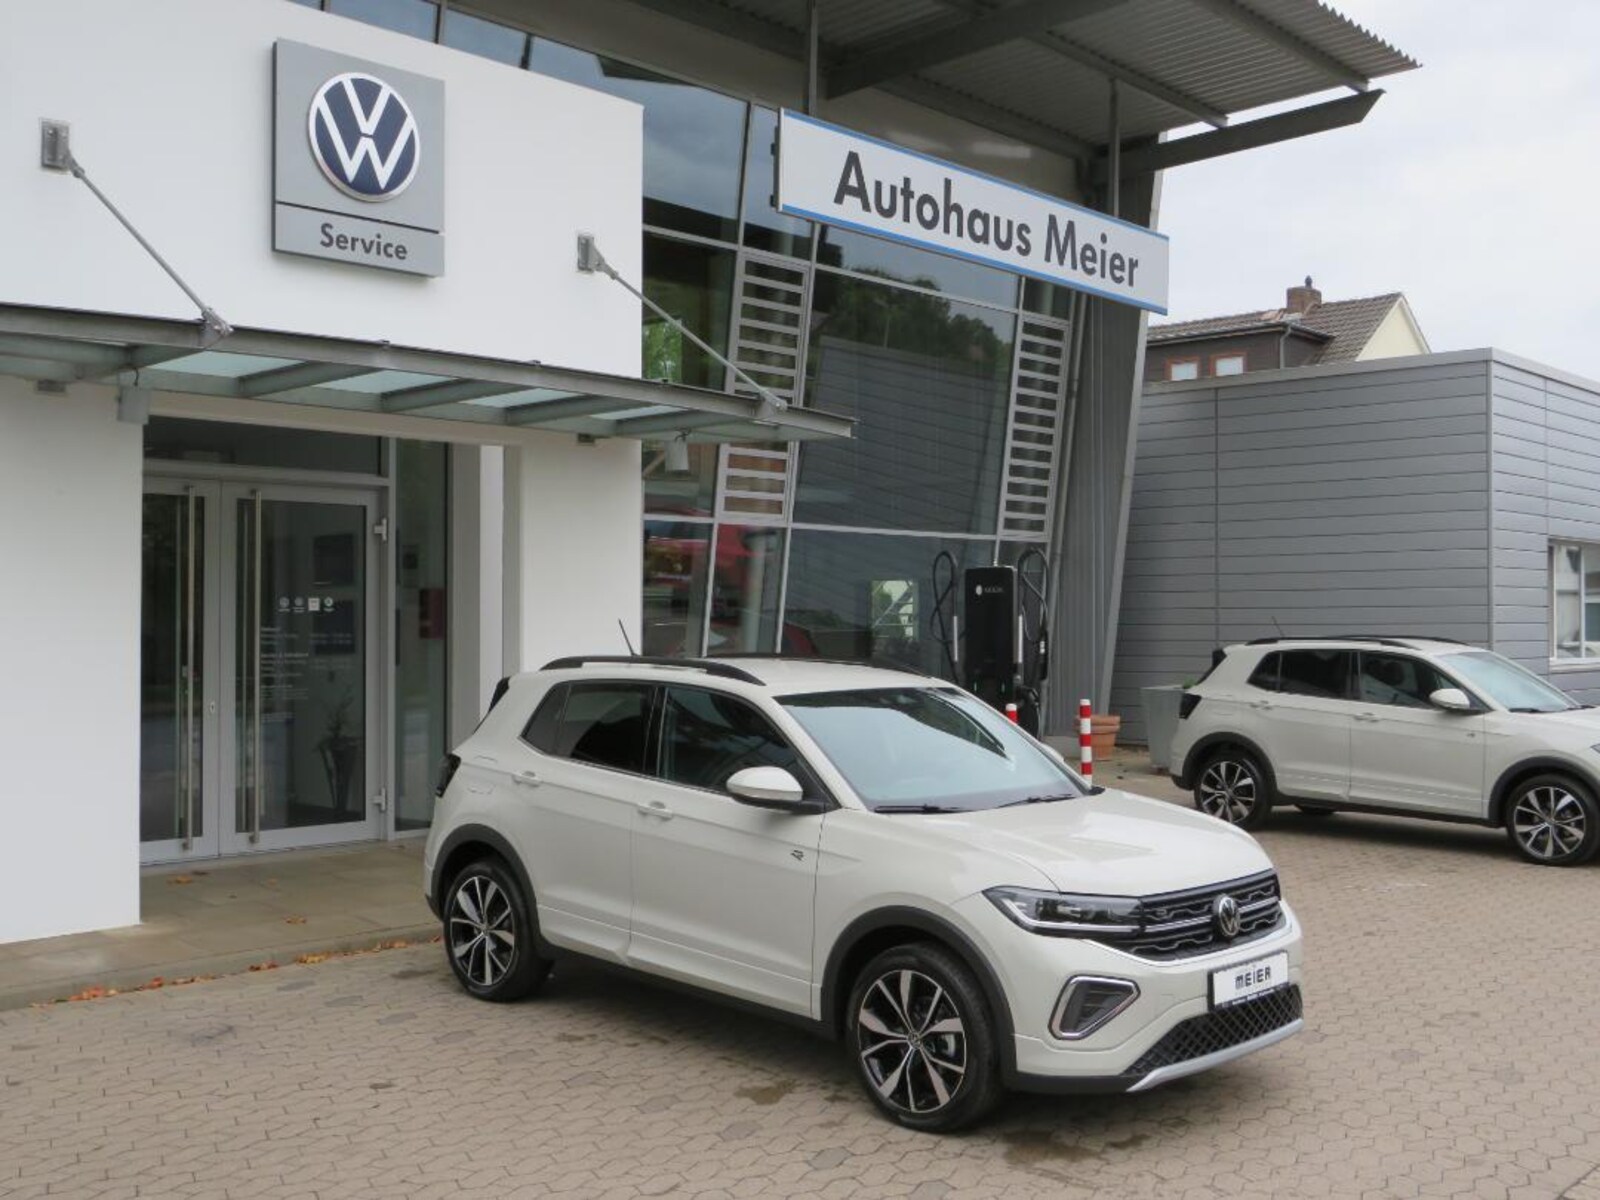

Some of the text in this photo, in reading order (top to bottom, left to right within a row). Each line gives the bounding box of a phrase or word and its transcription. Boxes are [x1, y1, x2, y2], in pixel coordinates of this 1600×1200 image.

[312, 75, 418, 196] VW
[320, 223, 407, 260] Service
[833, 150, 1138, 287] Autohaus Meier
[1235, 965, 1271, 990] MEIER
